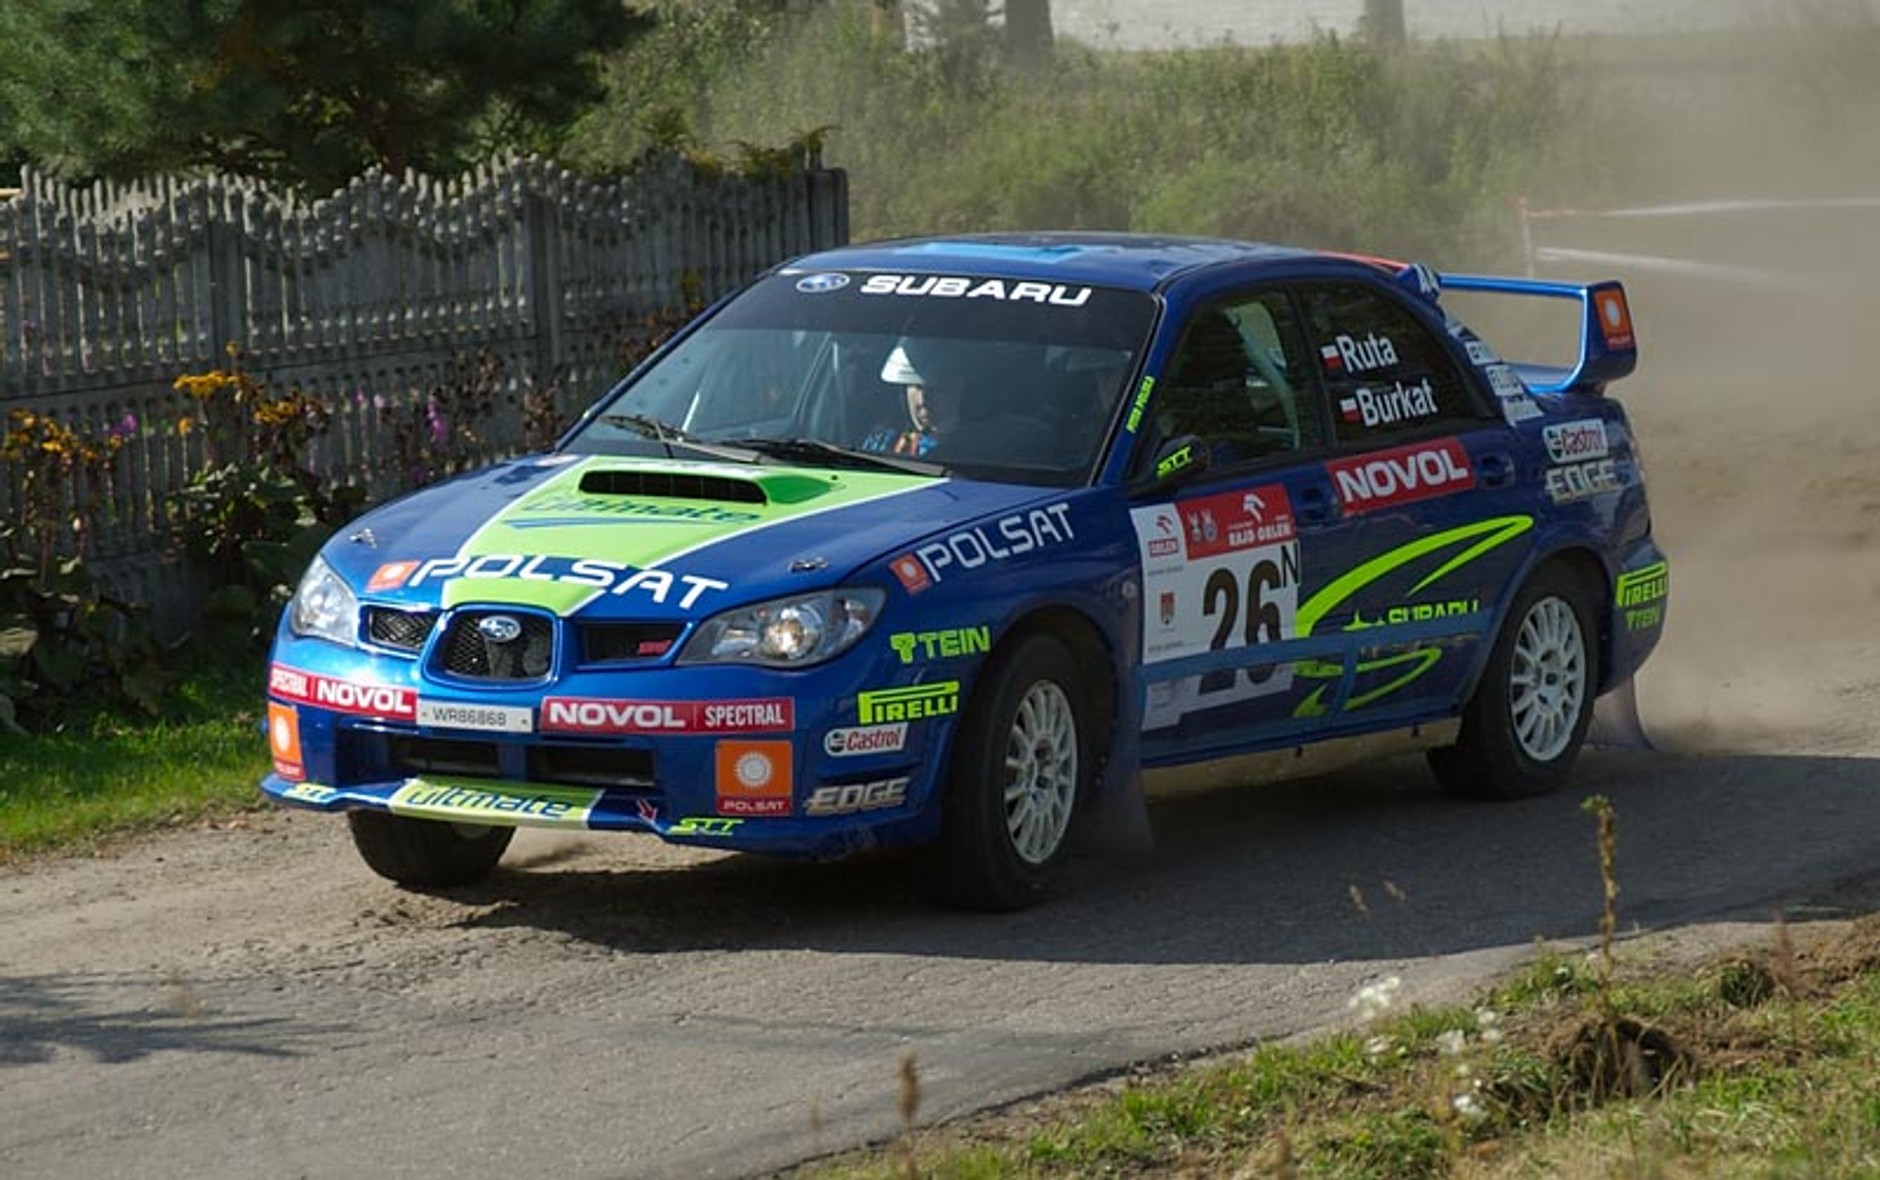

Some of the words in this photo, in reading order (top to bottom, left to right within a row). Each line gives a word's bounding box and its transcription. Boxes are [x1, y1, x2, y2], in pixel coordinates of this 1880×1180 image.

[860, 274, 1092, 306] SUBARU
[1336, 332, 1399, 373] Ruta
[1356, 378, 1438, 427] Burkat
[1336, 449, 1468, 502] NOVOL
[917, 503, 1074, 582] POLSAT
[407, 553, 729, 610] POLSAT
[1281, 541, 1299, 588] N
[917, 625, 992, 659] TEIN
[1199, 559, 1282, 695] 26
[316, 679, 412, 713] NOVOL
[549, 703, 686, 728] NOVOL
[704, 703, 786, 728] SPECTRAL
[858, 681, 960, 724] PIRELLI
[846, 729, 901, 752] Castrol
[406, 787, 572, 820] ultimate
[723, 801, 786, 812] POLSAT
[802, 777, 909, 816] EDGE
